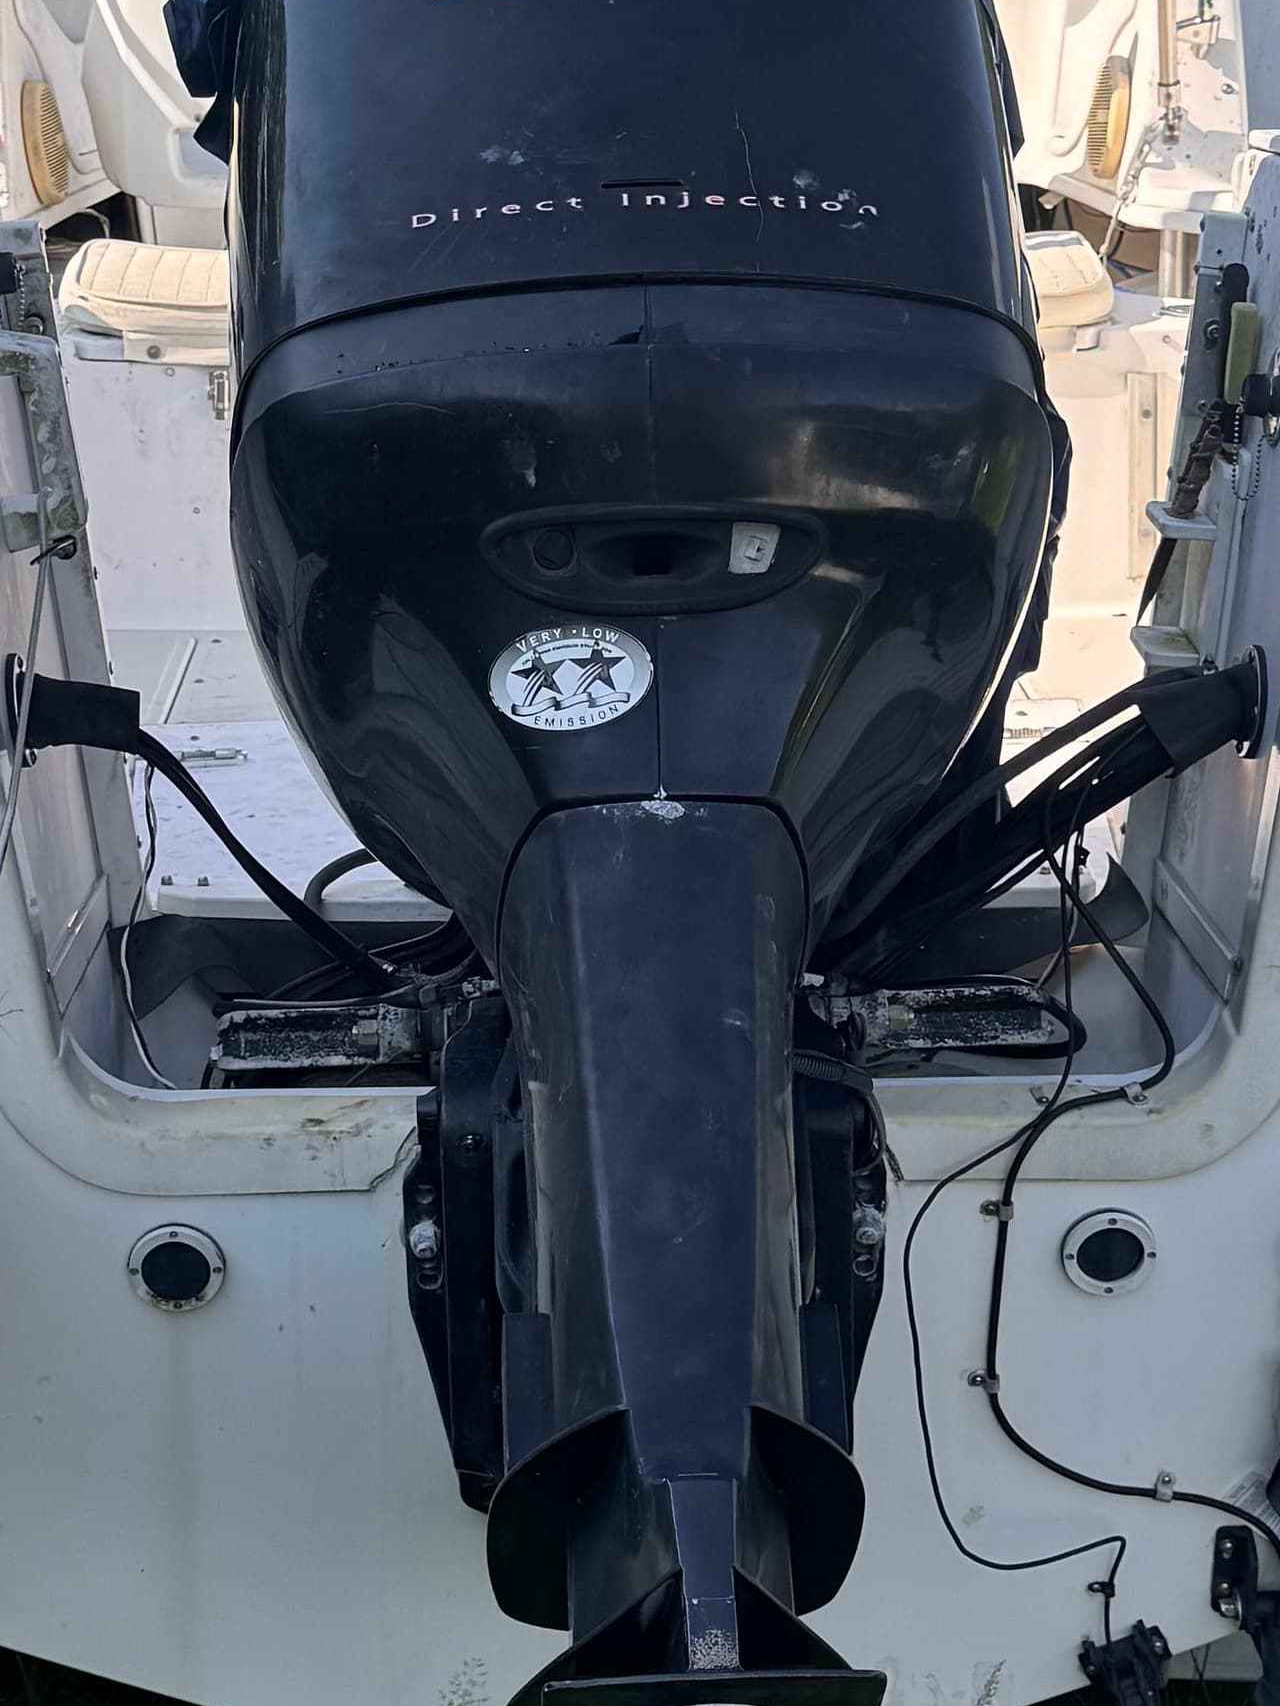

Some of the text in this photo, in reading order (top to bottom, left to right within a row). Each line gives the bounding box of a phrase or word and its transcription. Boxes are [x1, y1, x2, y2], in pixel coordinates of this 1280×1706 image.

[411, 191, 878, 229] Direct Injection
[516, 626, 620, 653] VERY LOW
[533, 703, 619, 728] EMISSION
